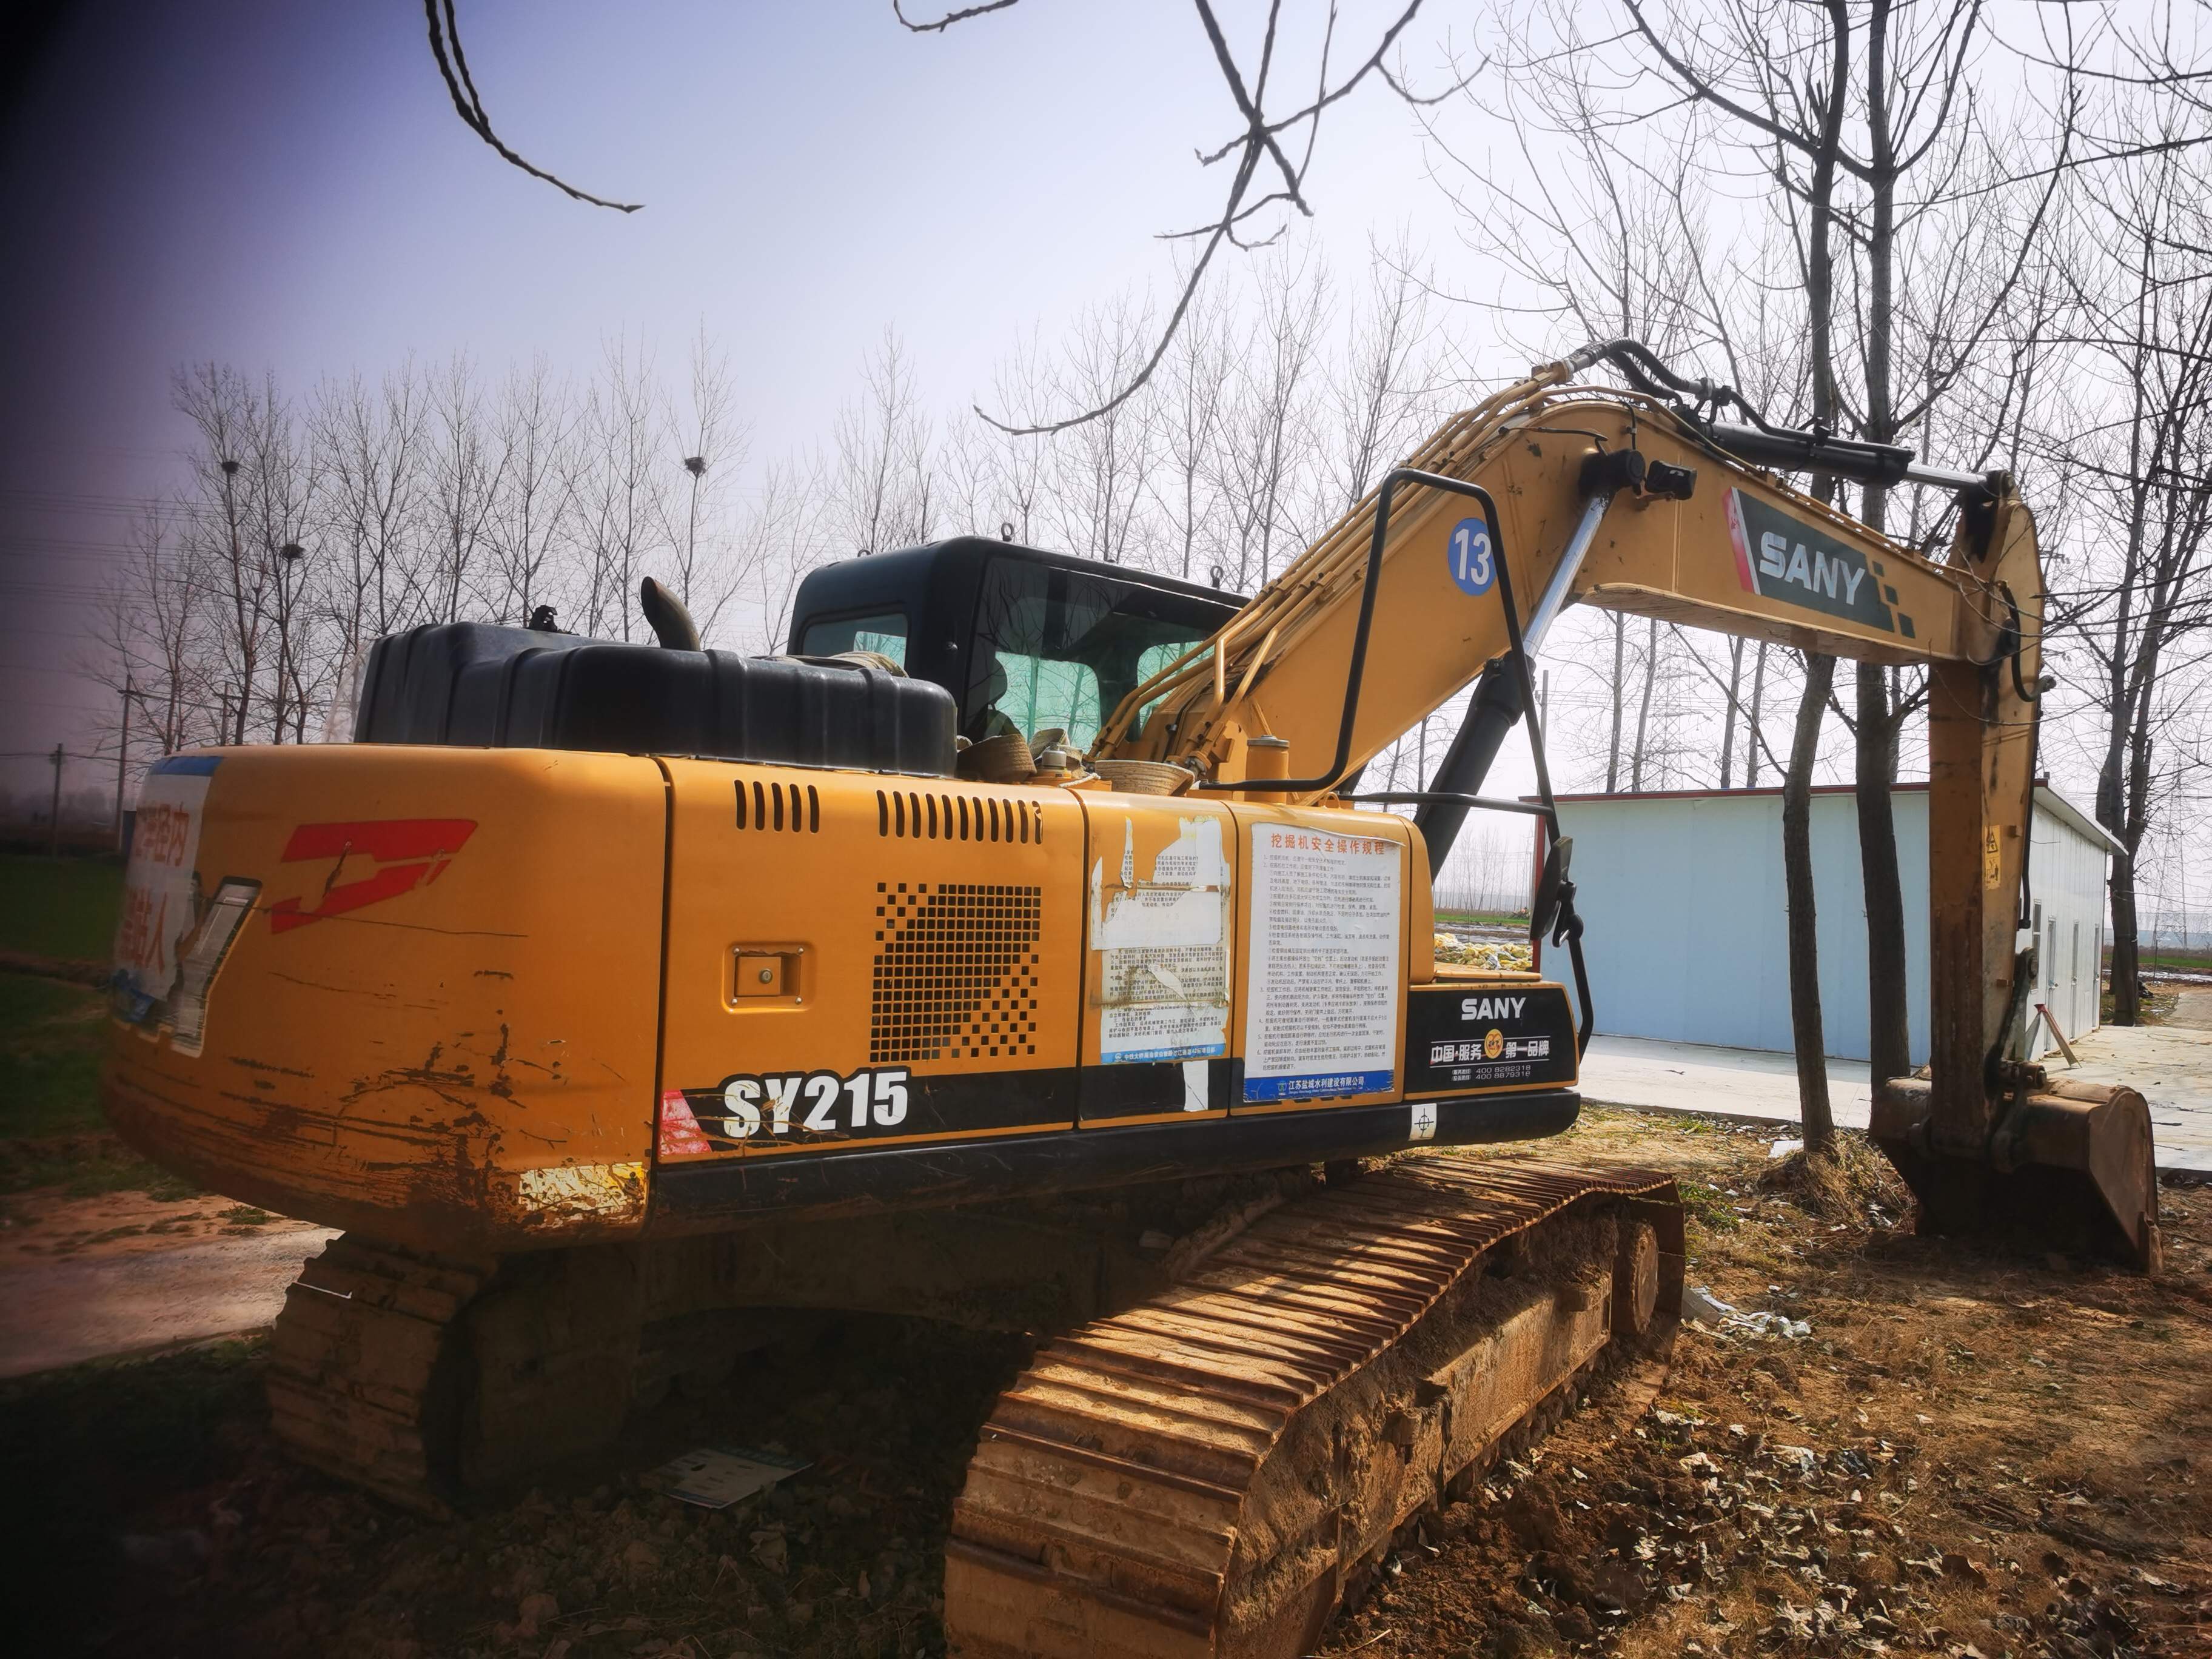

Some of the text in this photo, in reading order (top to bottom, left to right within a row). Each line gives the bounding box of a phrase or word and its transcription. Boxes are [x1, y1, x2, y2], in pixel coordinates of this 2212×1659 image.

[1455, 528, 1491, 585] 13
[1760, 531, 1866, 606] SANY
[1271, 833, 1386, 855] 挖掘机安全操作规程
[1461, 997, 1526, 1021] SANY
[1506, 1040, 1550, 1059] 第一品牌
[1289, 1076, 1364, 1090] 江苏盐城水利建设有限公司
[723, 1071, 908, 1138] SY215
